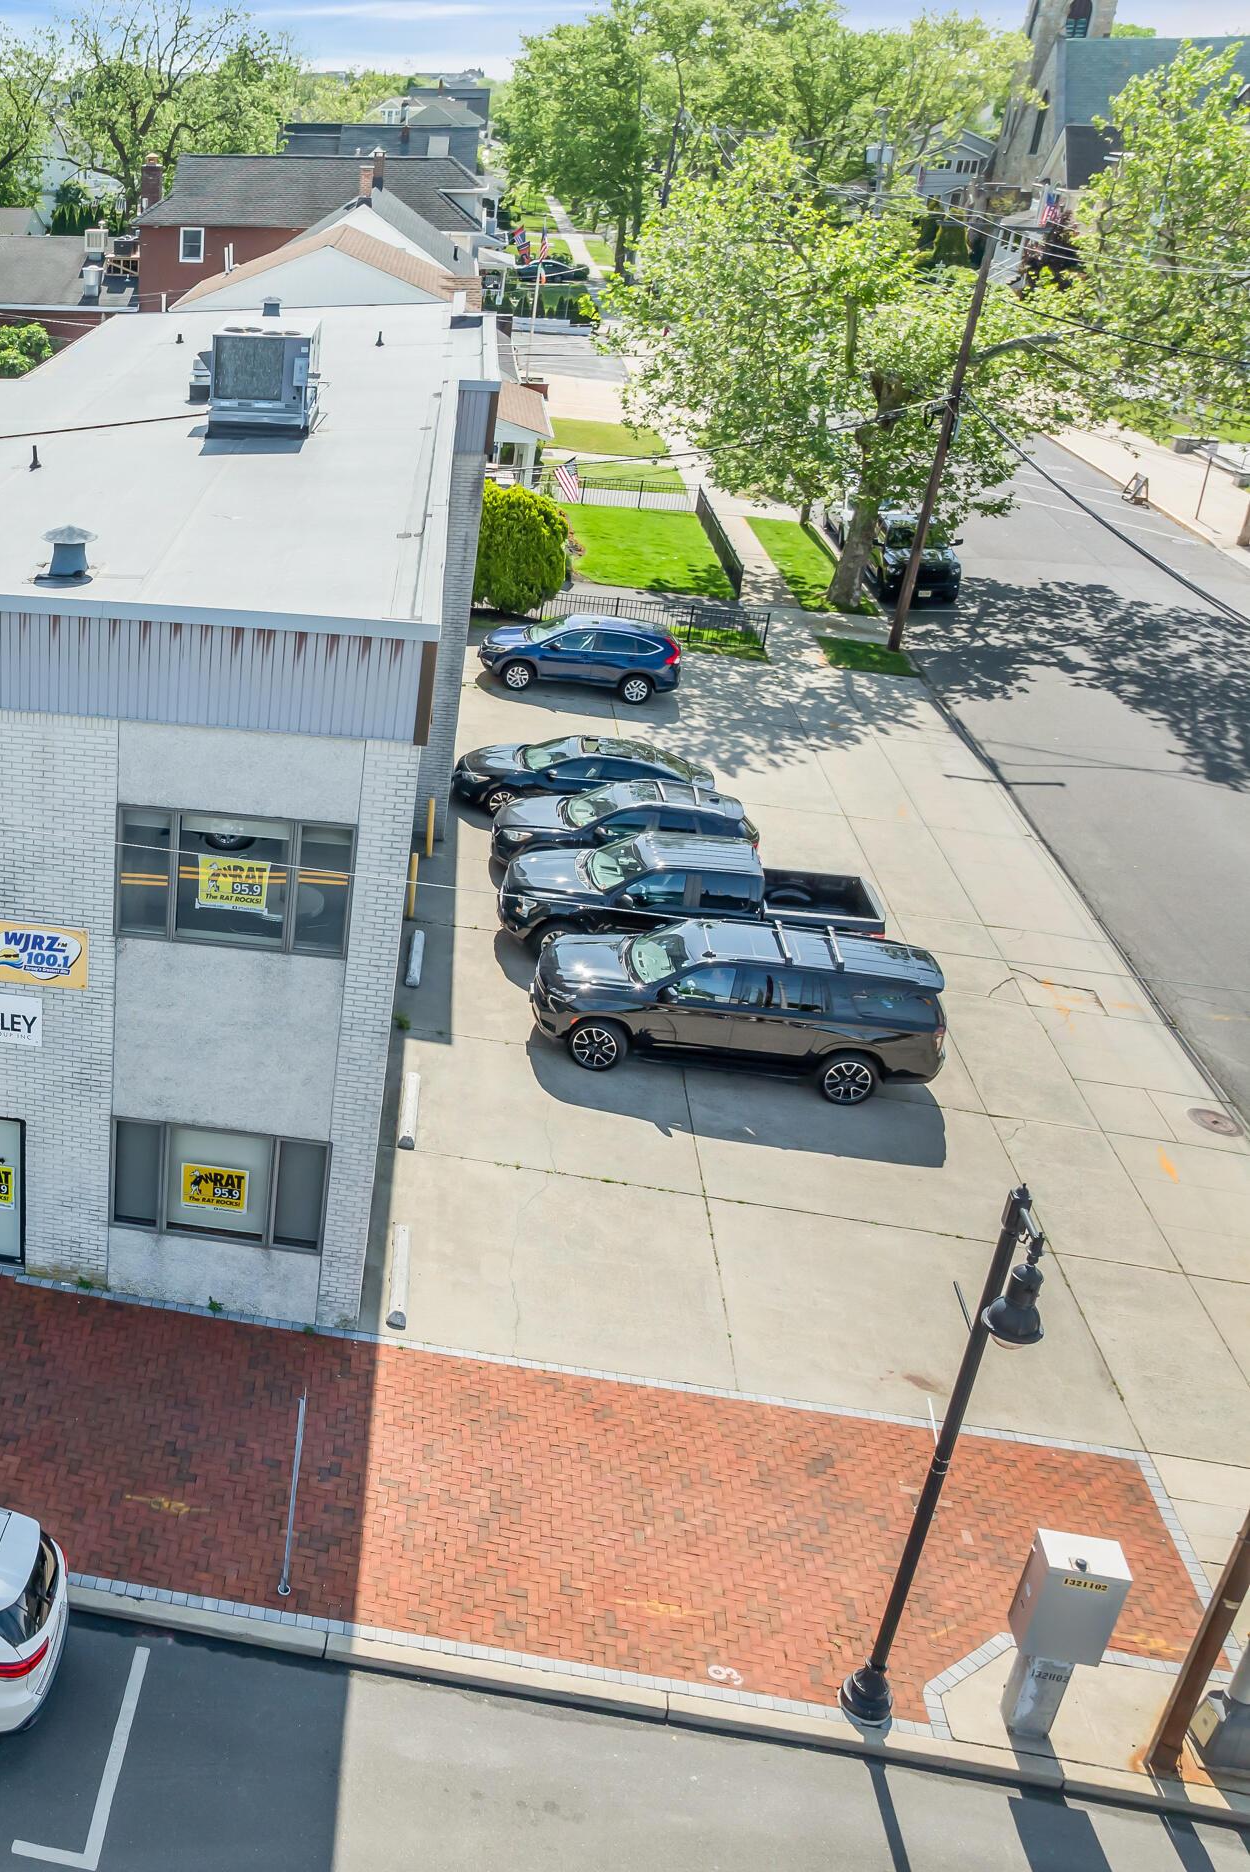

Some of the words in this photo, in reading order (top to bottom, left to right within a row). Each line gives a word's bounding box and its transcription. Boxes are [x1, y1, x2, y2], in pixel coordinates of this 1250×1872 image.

[233, 883, 261, 896] 95.9
[234, 896, 262, 904] ROCKS!
[4, 931, 66, 953] WJRZ
[26, 952, 70, 968] 100.1
[16, 1032, 32, 1040] INC
[214, 1187, 240, 1199] 95.9
[216, 1199, 240, 1207] ROCKS!
[1064, 1578, 1108, 1591] 1321102
[1031, 1668, 1070, 1683] 1321102
